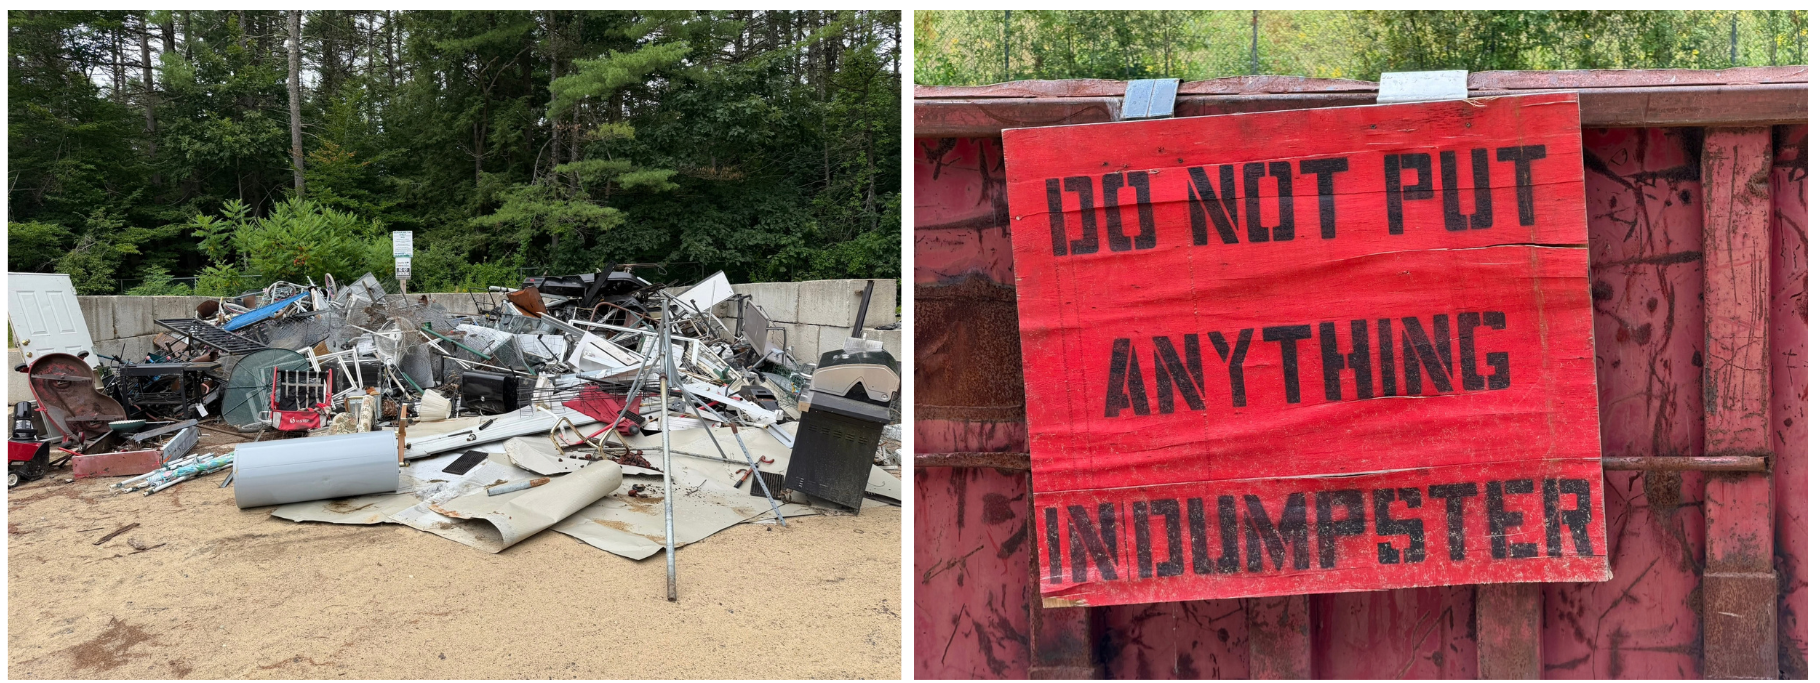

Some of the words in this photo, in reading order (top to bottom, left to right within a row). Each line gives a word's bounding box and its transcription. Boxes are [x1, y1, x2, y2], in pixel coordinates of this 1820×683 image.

[1047, 171, 1156, 256] DO
[1188, 158, 1348, 245] NOT
[1385, 145, 1546, 235] PUT
[1105, 312, 1510, 417] ANYTHING
